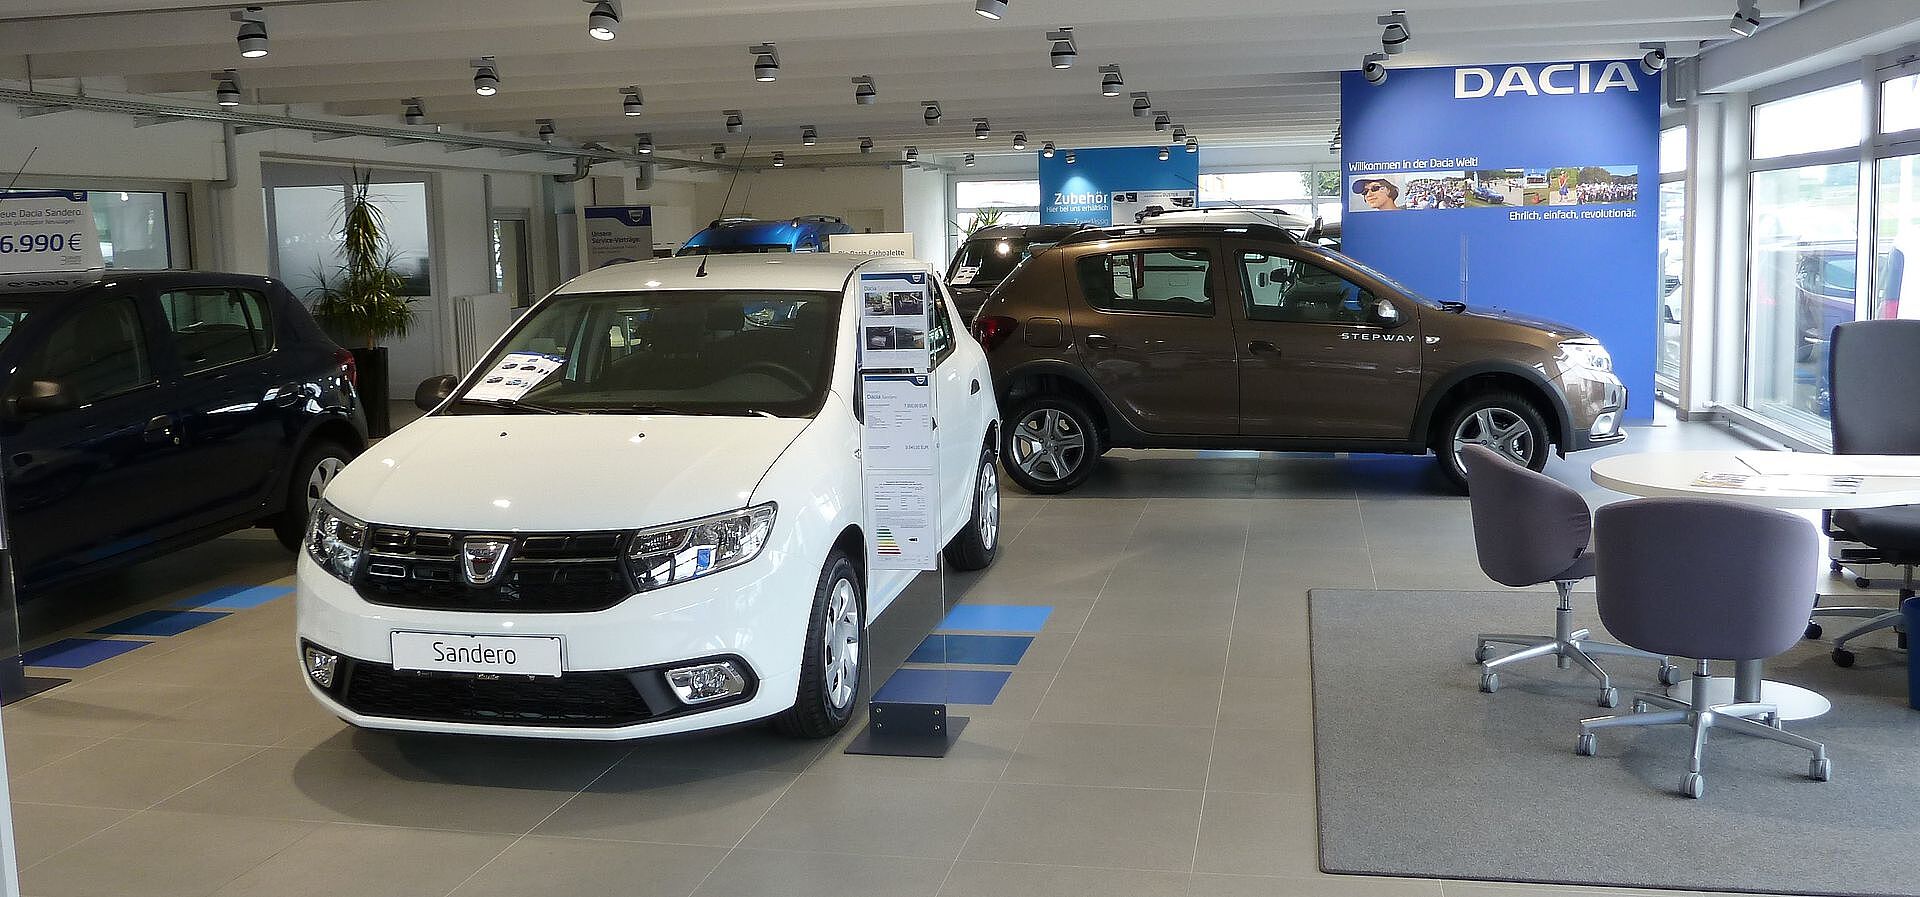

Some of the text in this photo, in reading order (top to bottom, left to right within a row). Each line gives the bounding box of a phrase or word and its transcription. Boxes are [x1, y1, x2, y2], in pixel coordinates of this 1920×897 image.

[1455, 62, 1639, 99] DACIA
[1348, 157, 1478, 172] Willkommen in der Dacia Welt!
[1054, 190, 1108, 205] Zubehör
[20, 209, 43, 218] Dacia
[1046, 205, 1058, 213] Hier
[1059, 205, 1069, 213] bei
[1081, 204, 1109, 212] erhältlich
[1509, 208, 1637, 221] Ehrlich, einfach, revolutionär.
[0, 233, 82, 254] 6.990 €
[1341, 332, 1415, 343] STEPWAY
[432, 641, 517, 665] Sandero
